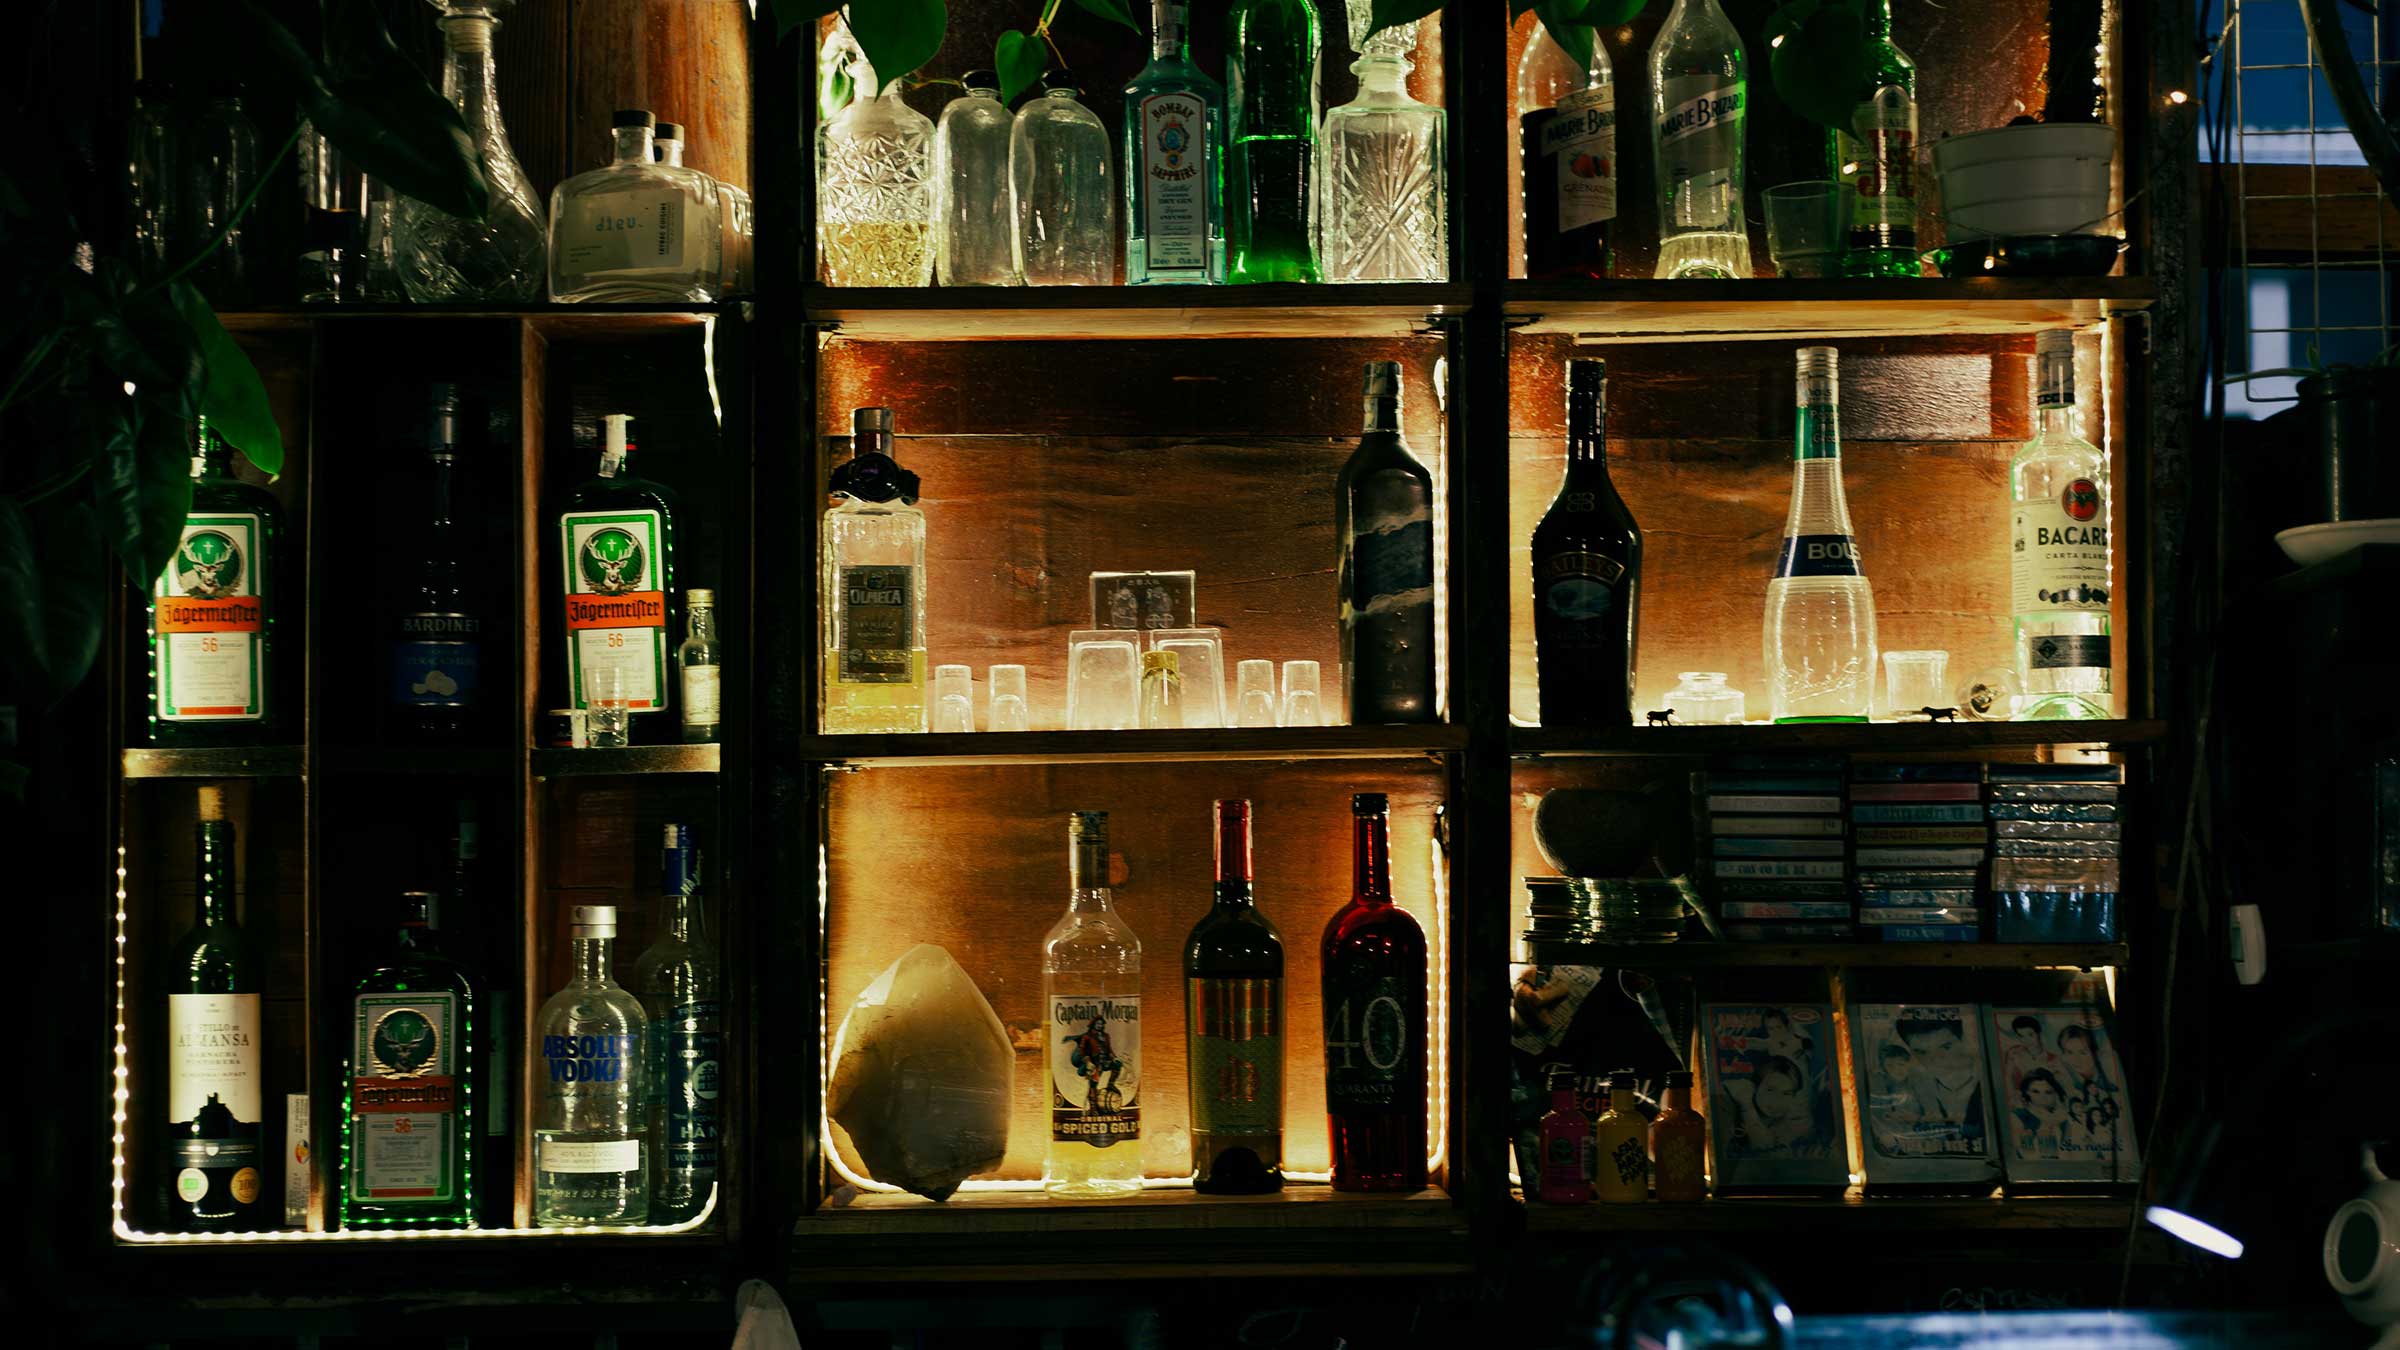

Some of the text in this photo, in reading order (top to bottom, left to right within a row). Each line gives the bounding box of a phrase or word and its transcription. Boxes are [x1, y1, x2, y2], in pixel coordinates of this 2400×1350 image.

[1151, 103, 1195, 120] BOMBAY
[1661, 107, 1694, 138] MARIE
[1150, 165, 1199, 182] SAPPHIRE
[1808, 541, 1863, 561] BOLS
[202, 638, 218, 652] 56
[608, 633, 624, 648] 56
[1056, 1001, 1098, 1025] Captain
[1327, 995, 1407, 1070] 40
[394, 1118, 413, 1134] 56
[1062, 1120, 1137, 1135] SPICED GOLD
[1080, 1115, 1123, 1123] ORIGINAL
